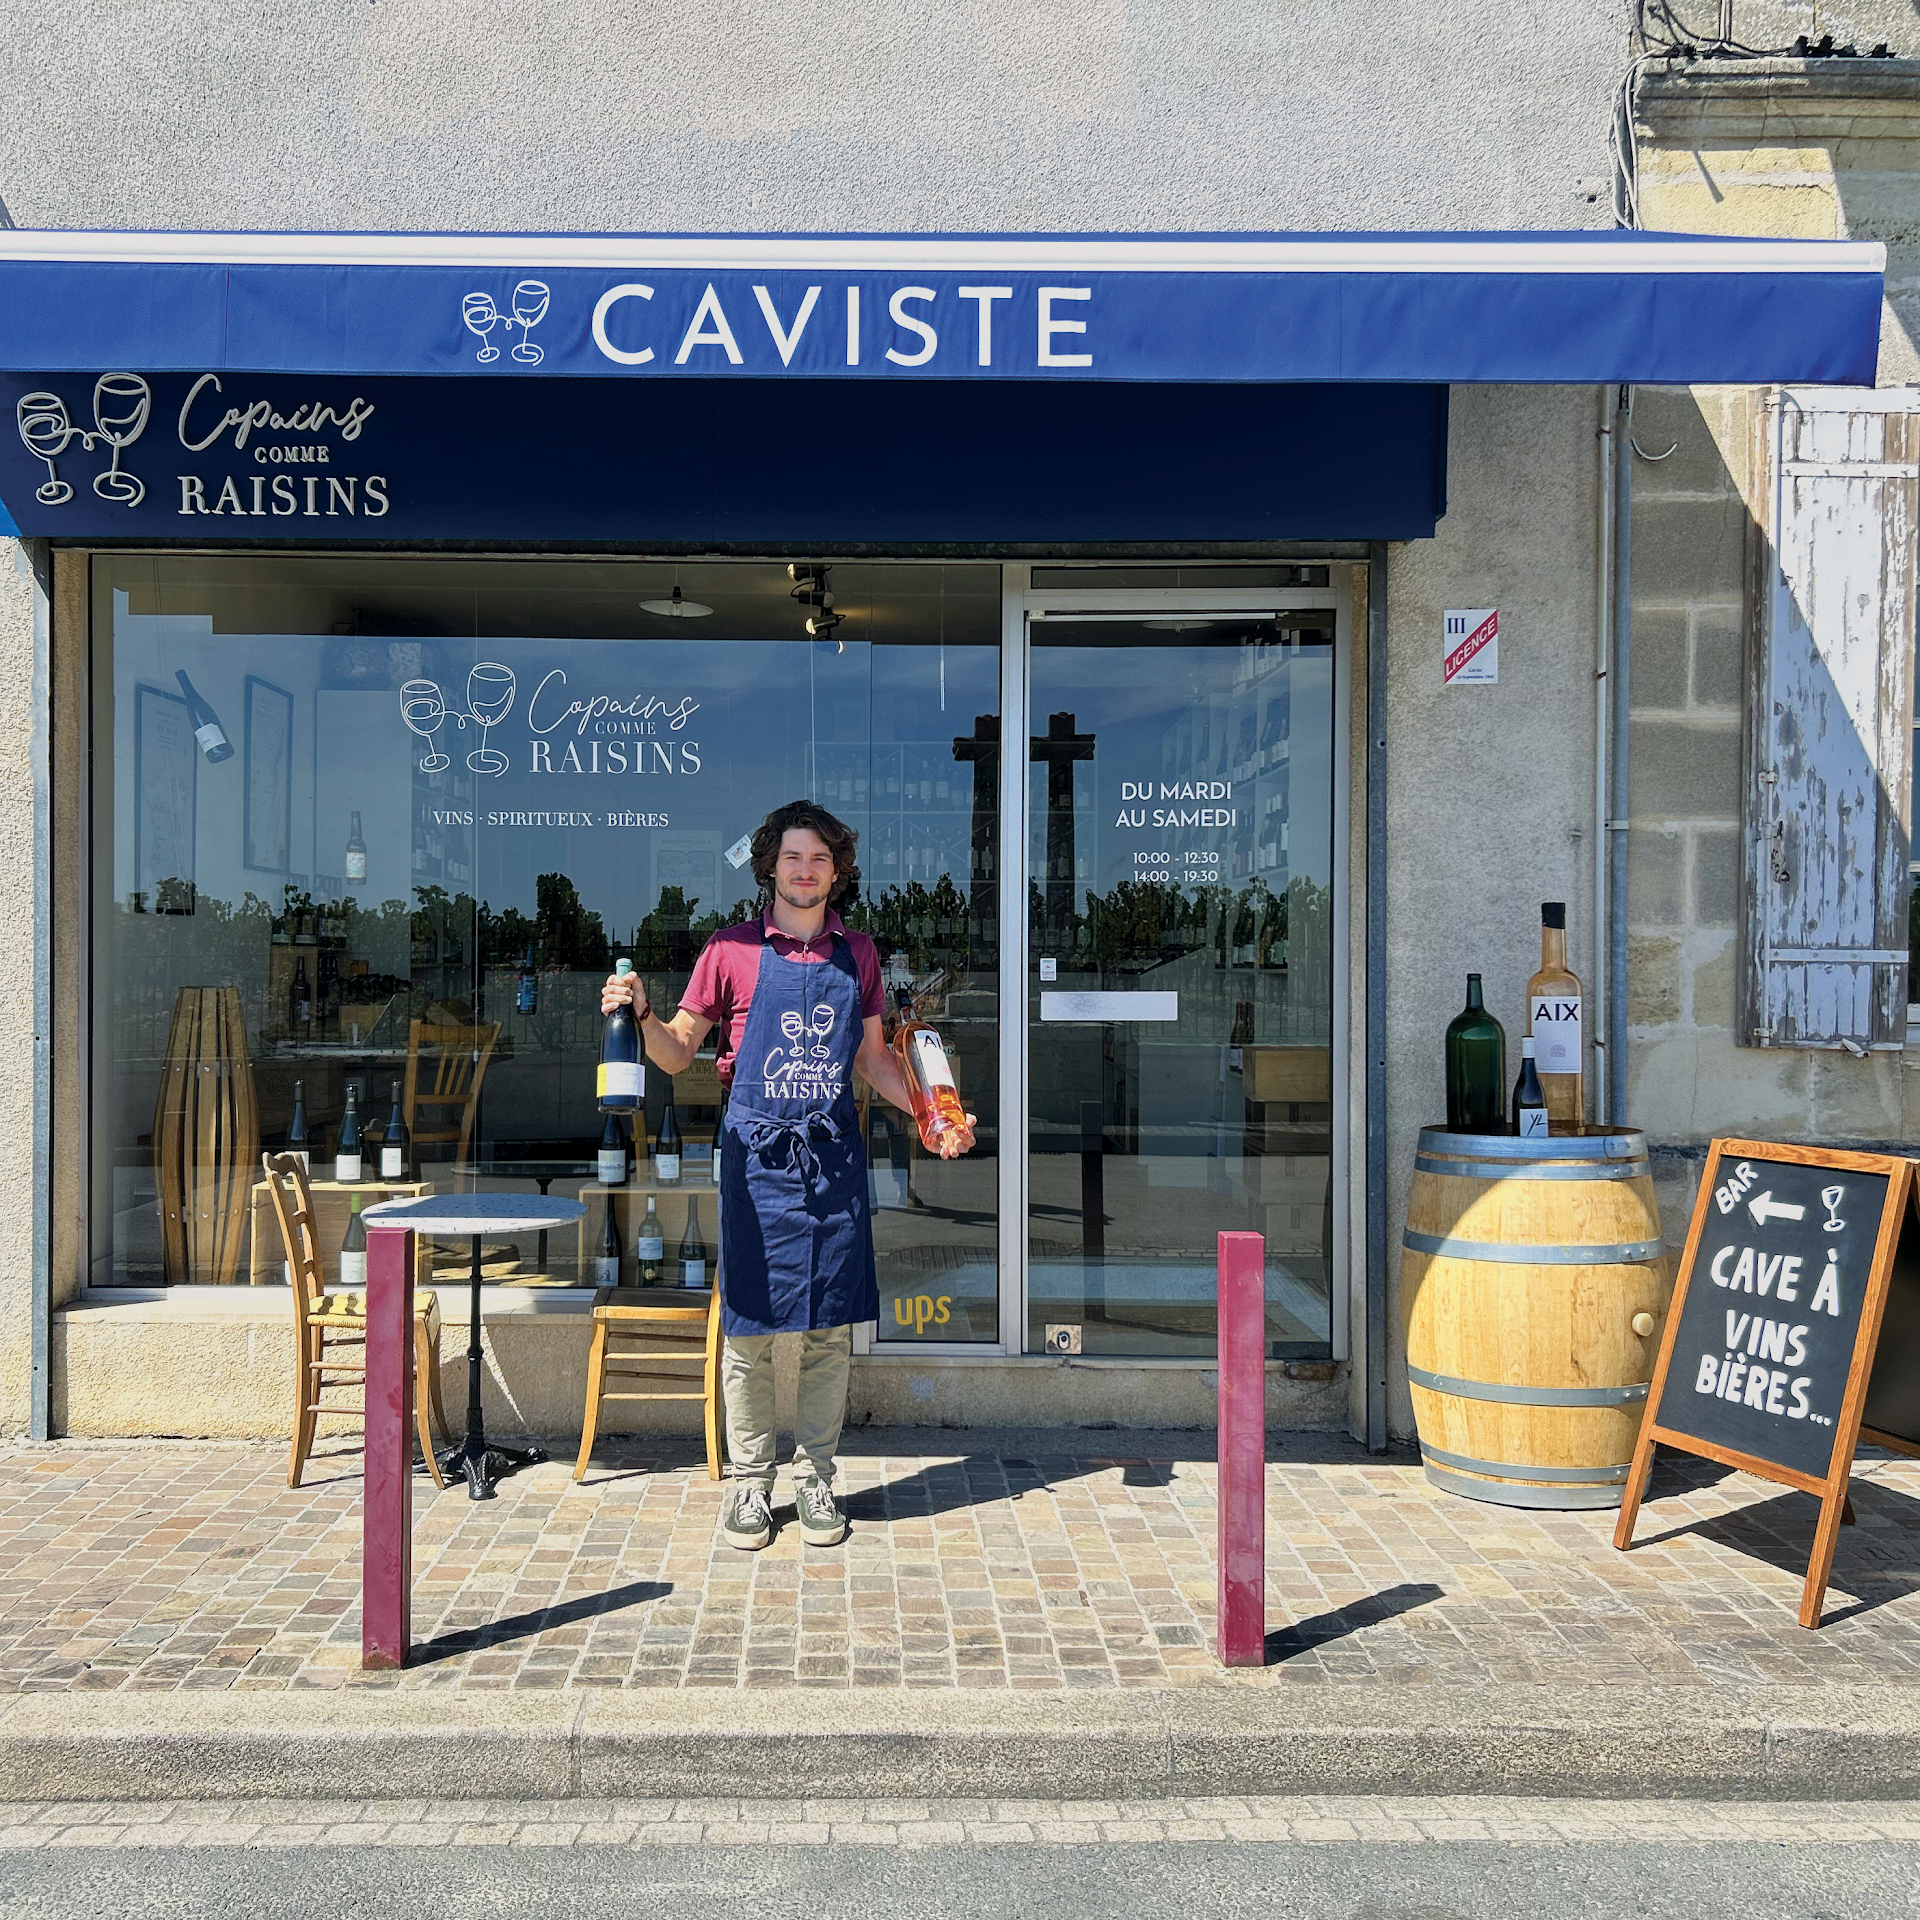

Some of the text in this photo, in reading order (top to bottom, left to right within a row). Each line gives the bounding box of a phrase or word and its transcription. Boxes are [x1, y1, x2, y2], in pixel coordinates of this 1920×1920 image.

[591, 281, 1094, 368] CAVISTE
[178, 373, 375, 451] Copains
[254, 446, 330, 463] COMME
[177, 475, 390, 516] RAISINS
[1447, 617, 1466, 634] III
[1446, 618, 1496, 677] LICENCE
[528, 669, 700, 735] Copains
[595, 721, 656, 735] COMME
[529, 740, 701, 775] RAISINS
[1121, 781, 1231, 800] DU MARDI
[433, 809, 669, 827] VINS SPIRITUEUX BIÈRES
[1115, 809, 1236, 827] AU SAMEDI
[1133, 852, 1170, 864] 10:00
[1184, 852, 1219, 864] 12:30
[1133, 870, 1170, 882] 14:00
[1183, 870, 1218, 882] 19:30
[1534, 1003, 1579, 1021] AIX
[923, 1034, 943, 1050] AI
[764, 1047, 842, 1080] Copains
[763, 1081, 842, 1100] RAISINS
[1715, 1161, 1758, 1215] BAR
[1711, 1245, 1839, 1316] CAVE À
[894, 1294, 951, 1334] ups
[1726, 1309, 1808, 1367] VINS
